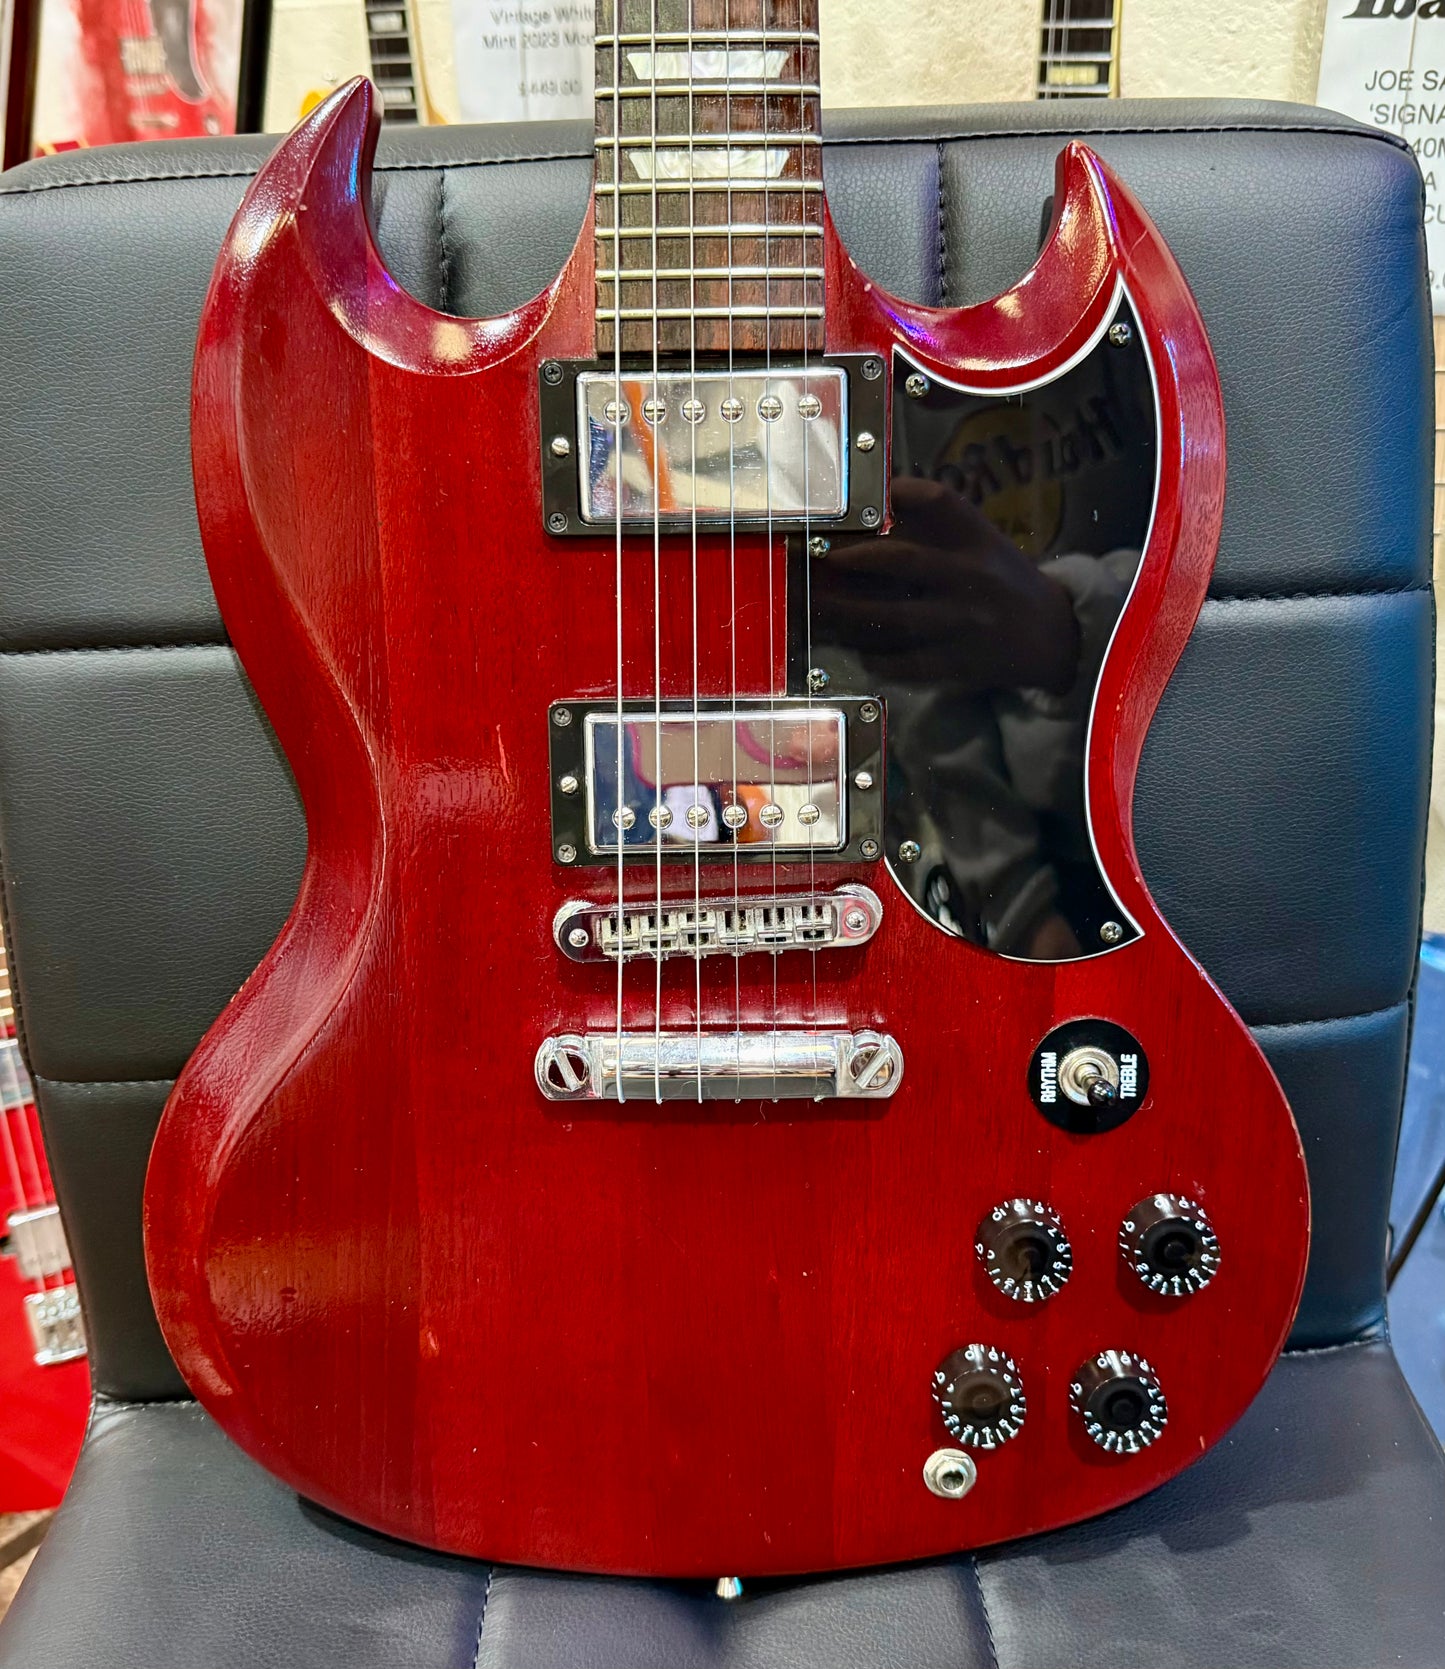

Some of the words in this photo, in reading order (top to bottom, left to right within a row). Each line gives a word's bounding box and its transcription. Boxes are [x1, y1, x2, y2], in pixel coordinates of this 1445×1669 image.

[1365, 70, 1415, 91] JOE
[1040, 1051, 1057, 1103] RHYTHM
[1120, 1053, 1137, 1099] TREBLE
